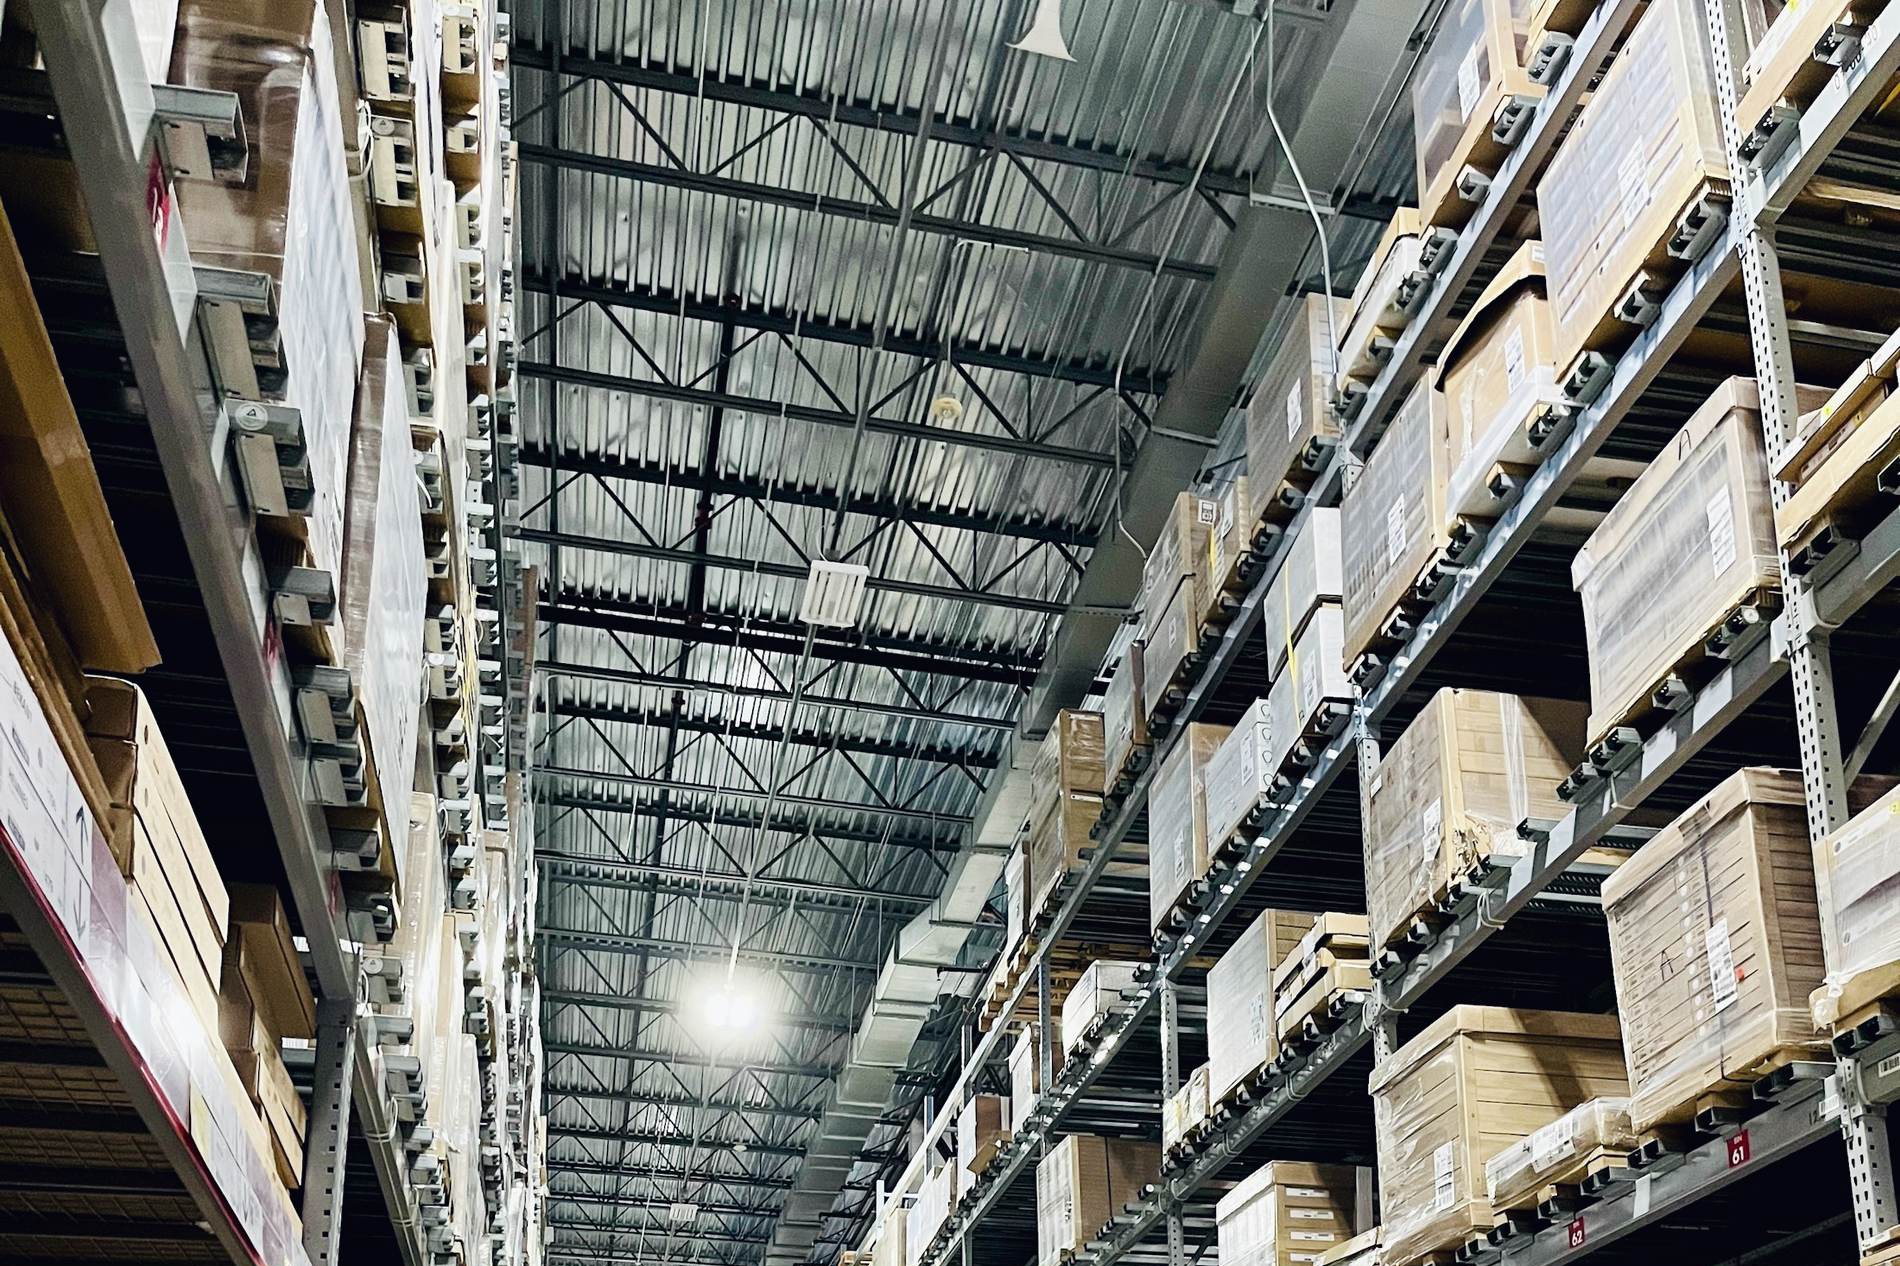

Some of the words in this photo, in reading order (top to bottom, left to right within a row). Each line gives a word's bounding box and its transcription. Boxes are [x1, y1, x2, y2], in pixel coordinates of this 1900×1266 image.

[1660, 950, 1674, 981] A
[1732, 1145, 1745, 1165] 61
[1571, 1230, 1584, 1247] 62
